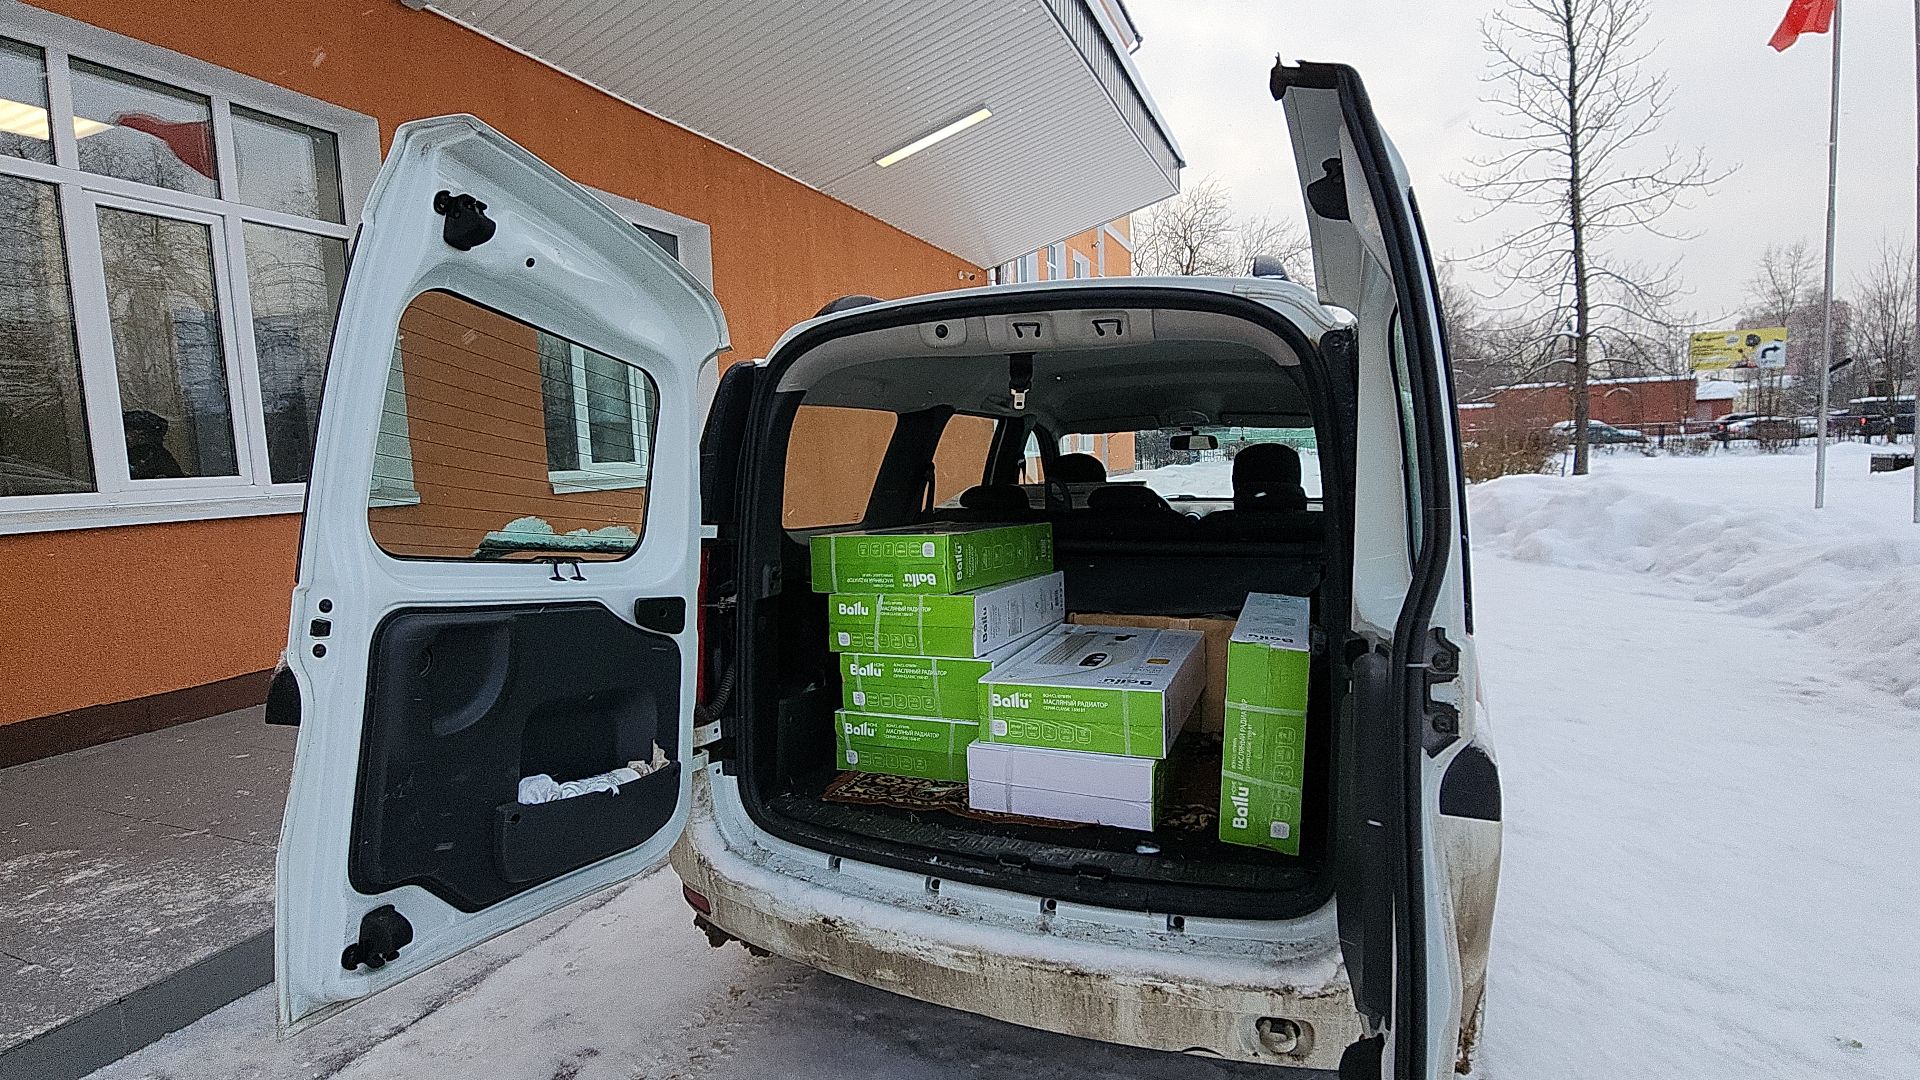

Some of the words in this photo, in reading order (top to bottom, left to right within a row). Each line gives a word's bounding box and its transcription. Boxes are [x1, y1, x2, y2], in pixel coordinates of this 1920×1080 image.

[955, 545, 963, 581] Ballu
[904, 573, 937, 588] Ballu
[838, 601, 869, 615] Ballu
[850, 662, 882, 677] Ballu
[992, 692, 1029, 709] Ballu
[1077, 700, 1109, 709] РАДИАТОР
[844, 722, 875, 737] Ballu
[914, 731, 940, 739] РАДИАТОР
[1237, 733, 1247, 770] МАСЛЯНЫЙ
[1230, 786, 1249, 829] Ballu
